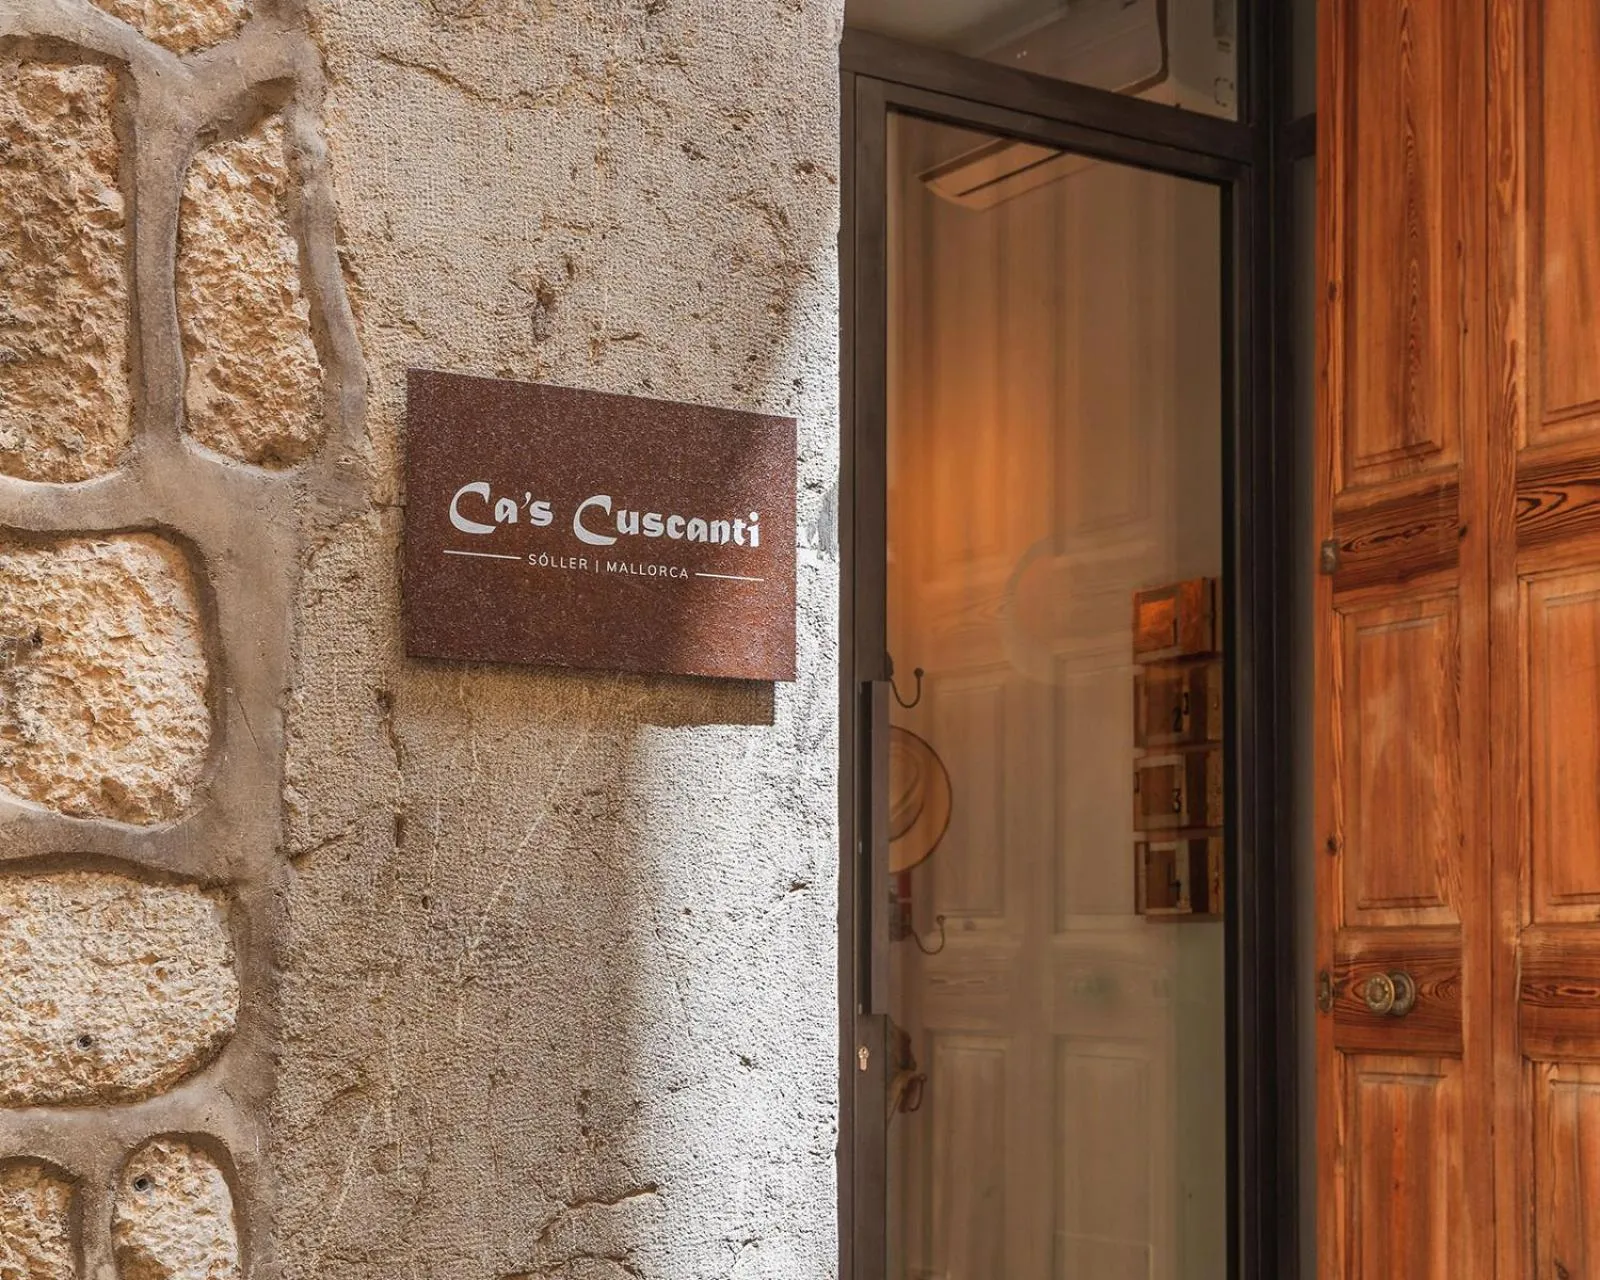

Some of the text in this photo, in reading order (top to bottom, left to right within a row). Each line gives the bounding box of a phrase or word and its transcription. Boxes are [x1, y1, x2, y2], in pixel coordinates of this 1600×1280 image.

[449, 481, 760, 547] Ca's Cuscanti
[528, 552, 588, 570] SÓLLER
[606, 560, 689, 579] MALLORCA
[1171, 788, 1182, 814] 3
